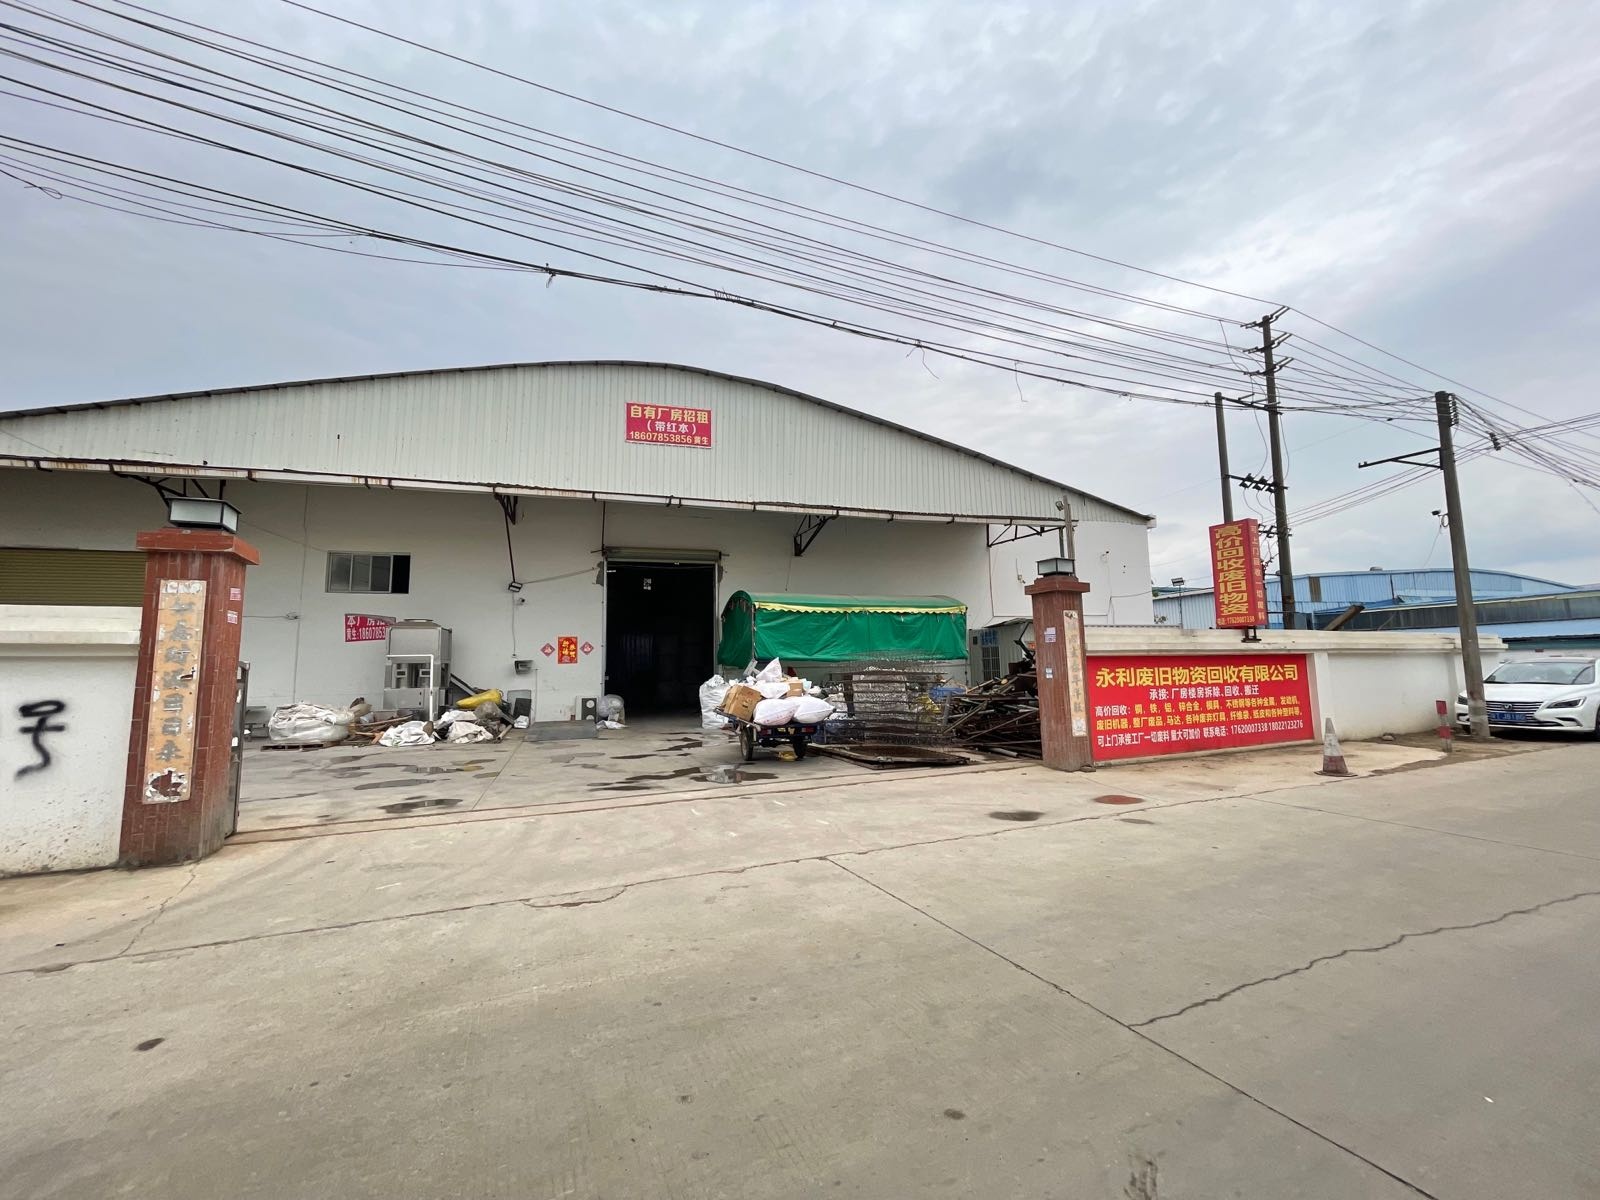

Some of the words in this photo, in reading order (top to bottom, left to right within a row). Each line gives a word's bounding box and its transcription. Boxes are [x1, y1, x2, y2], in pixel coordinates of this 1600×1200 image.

[630, 405, 709, 424] 自有厂房招租
[629, 431, 692, 443] 18607853856
[1215, 524, 1249, 616] 高价回收废旧物资
[1095, 664, 1298, 688] 永利废旧物资回收有限公司
